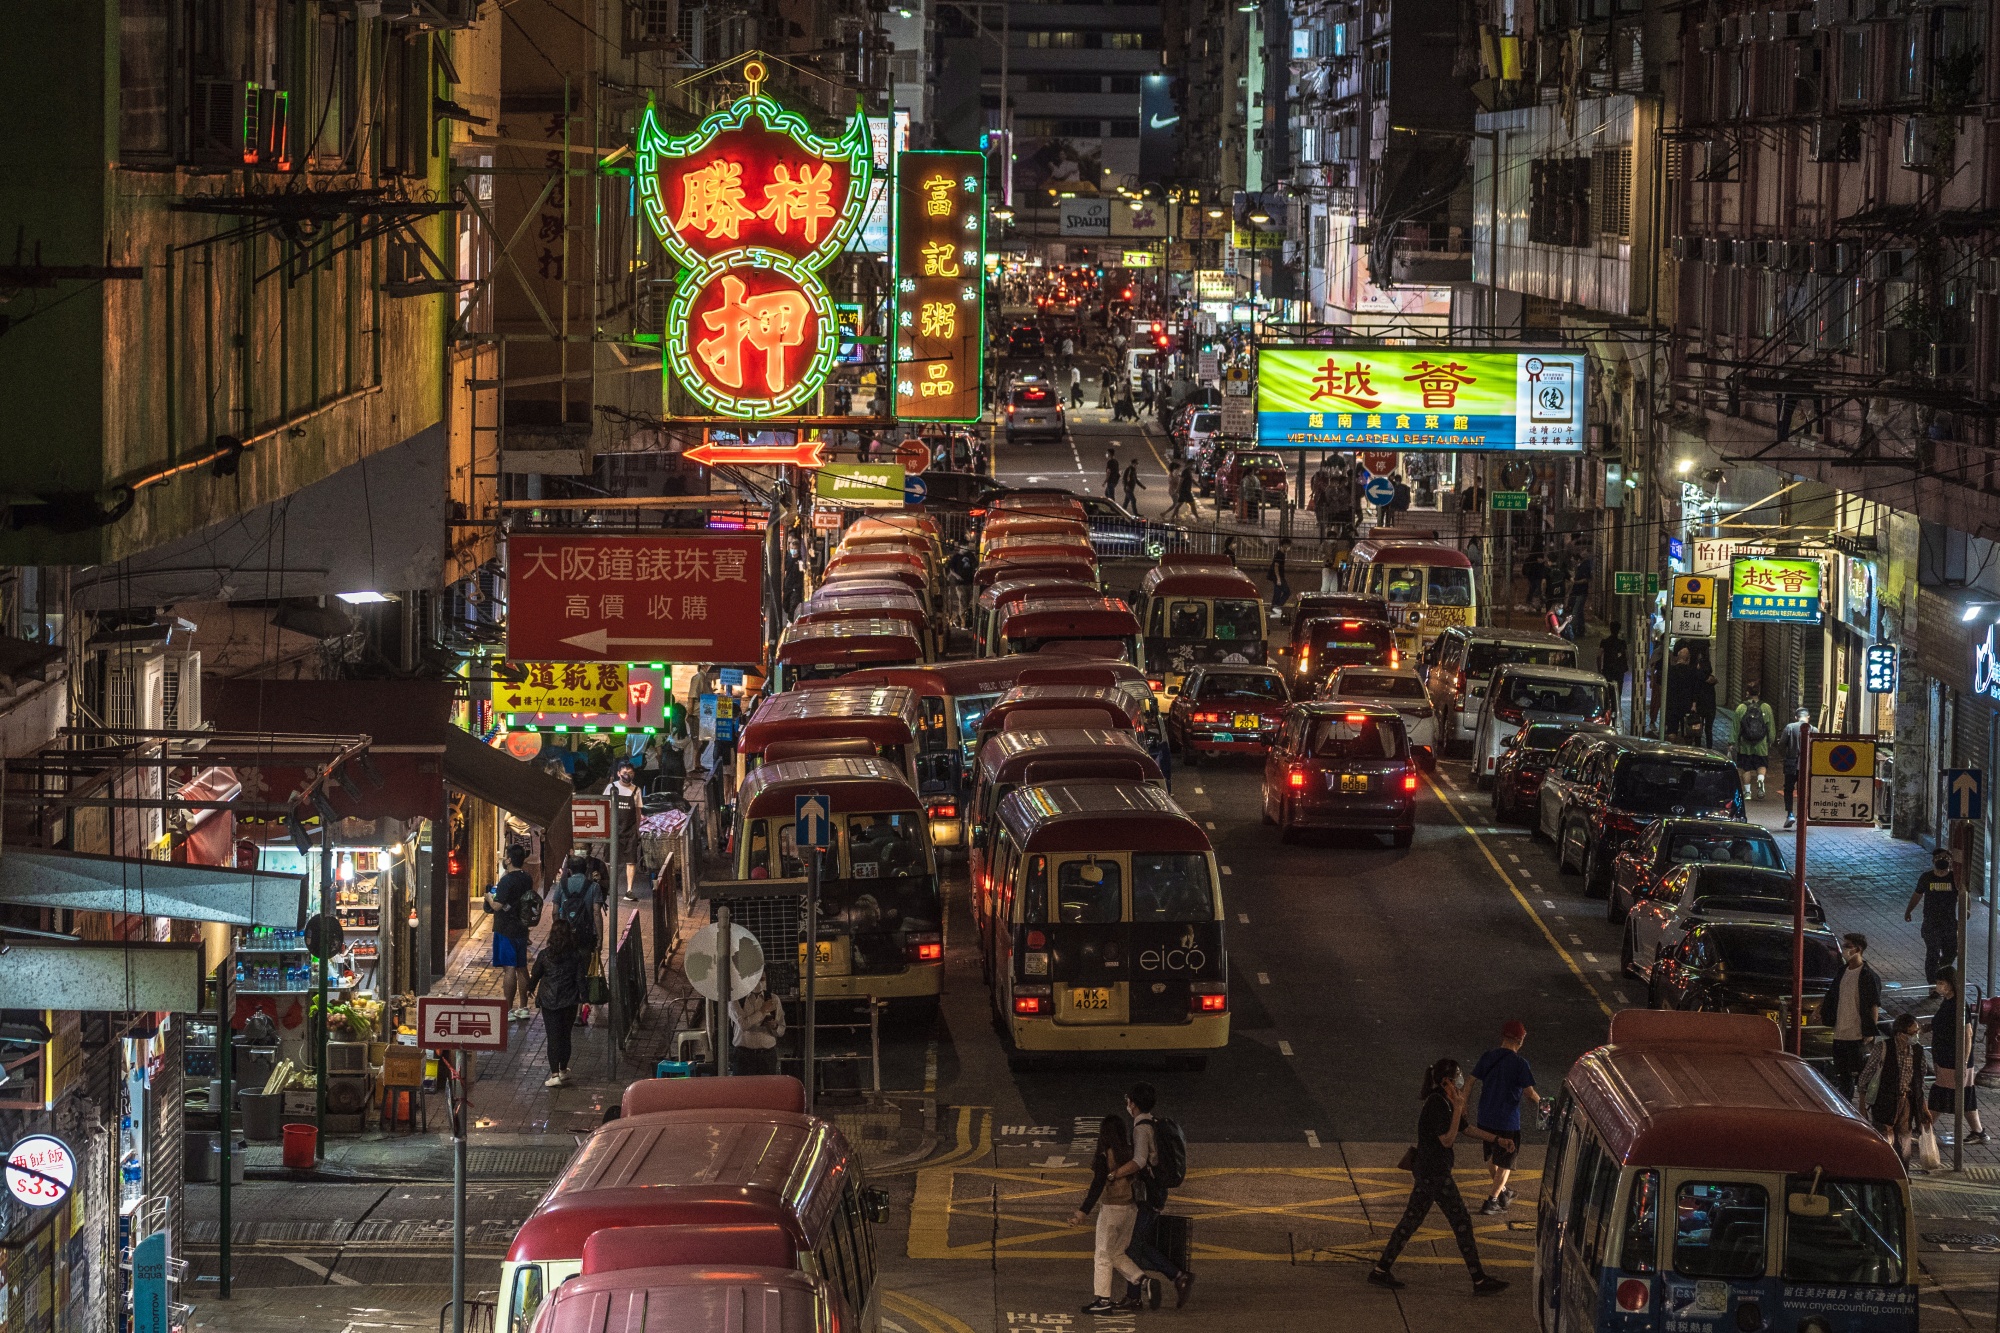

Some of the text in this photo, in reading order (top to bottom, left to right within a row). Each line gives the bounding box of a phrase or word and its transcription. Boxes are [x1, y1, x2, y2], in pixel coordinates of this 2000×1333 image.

[920, 174, 960, 398] 富記粥品
[697, 275, 810, 393] 押
[1309, 357, 1477, 409] 越薈
[1309, 414, 1469, 431] 越南美食菜館
[1287, 433, 1486, 446] VIETNAM GARDEN RESTAURANT
[1375, 461, 1386, 471] 停
[833, 471, 889, 491] prince
[522, 545, 748, 583] 大阪鐘錶珠寶
[1742, 566, 1812, 592] 越薈
[565, 594, 708, 621] 高價 收購
[1683, 610, 1701, 619] End
[1679, 621, 1703, 632] 終止
[1821, 784, 1840, 794] 上午
[1850, 780, 1861, 794] 7
[1813, 801, 1847, 809] midnight
[1851, 803, 1869, 818] 12
[1820, 808, 1839, 817] 午夜
[1083, 989, 1099, 998] WK
[1075, 1000, 1108, 1009] 4022
[138, 1264, 156, 1272] bon
[138, 1272, 162, 1281] aqua
